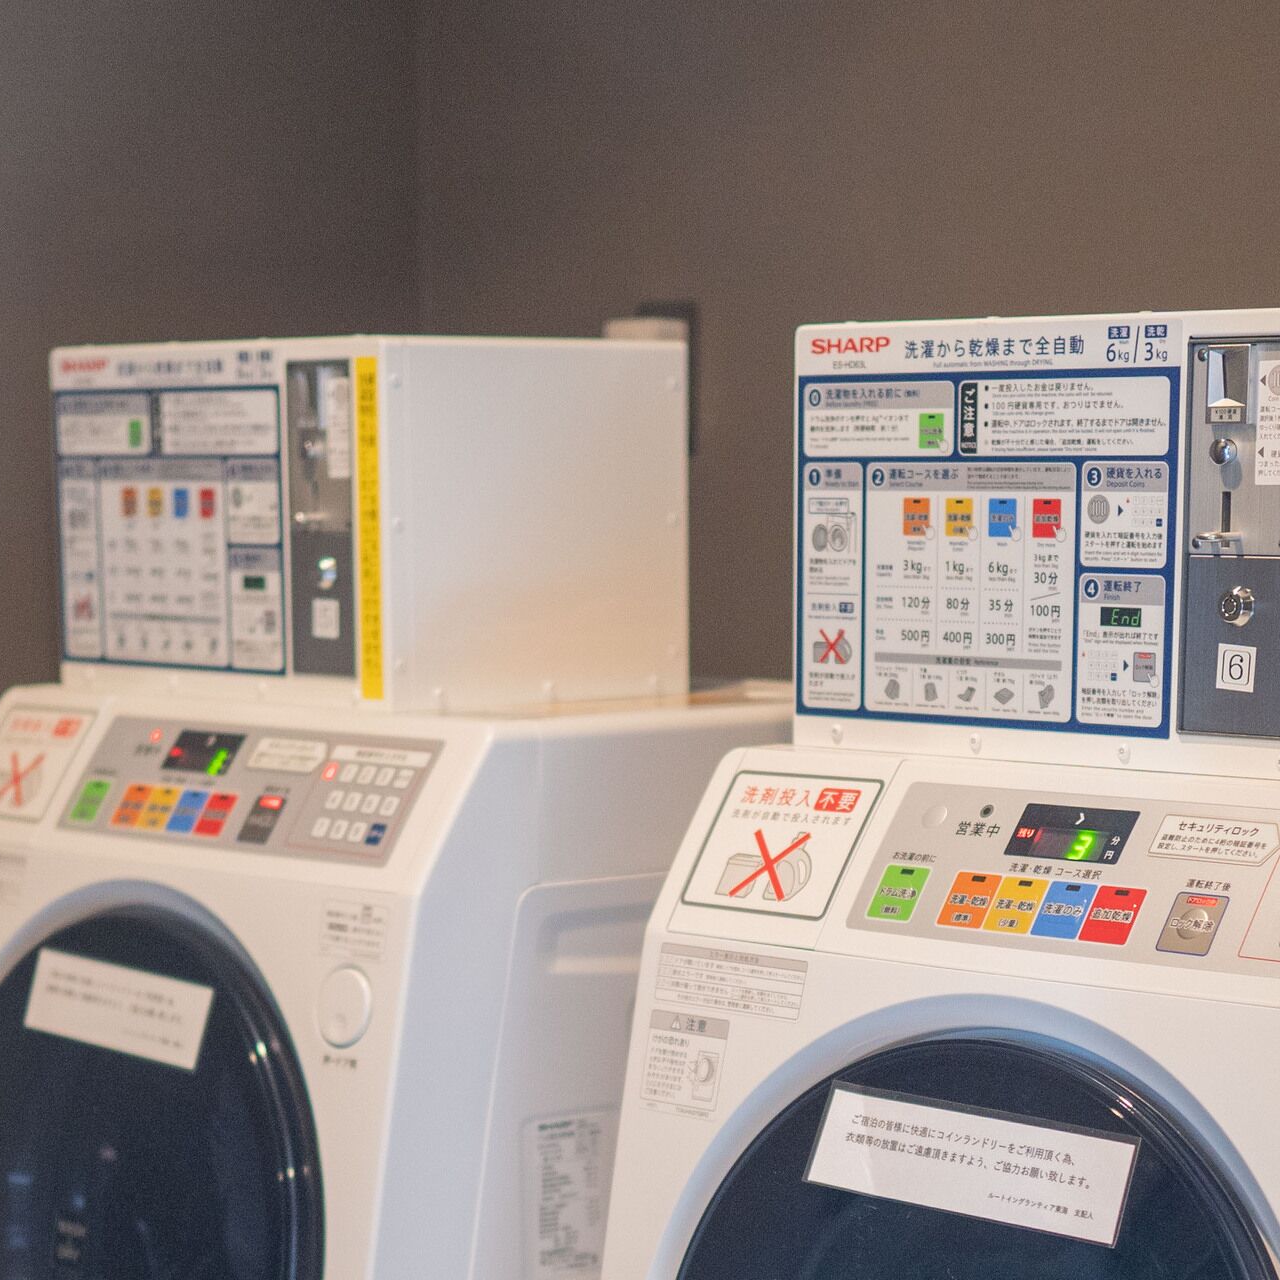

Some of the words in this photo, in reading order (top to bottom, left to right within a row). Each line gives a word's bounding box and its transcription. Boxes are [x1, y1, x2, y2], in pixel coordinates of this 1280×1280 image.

[811, 336, 890, 355] SHARP
[904, 335, 1085, 359] 洗濯から乾燥まで全自動
[963, 388, 976, 438] ご注意
[889, 468, 959, 480] 運転コースを選ぶ
[1106, 467, 1162, 479] 硬貨を入れる
[1103, 579, 1142, 592] 運転終了
[946, 597, 970, 611] 80分
[989, 599, 1013, 612] 35分
[1030, 604, 1061, 618] 100円
[1111, 608, 1141, 626] End
[901, 630, 930, 643] 500円
[942, 632, 972, 645] 400円
[986, 633, 1016, 646] 300円
[1229, 654, 1244, 680] 6
[740, 785, 810, 807] 洗剤投入
[819, 791, 859, 811] 不要
[955, 821, 1001, 838] 営業中
[1178, 820, 1260, 837] セキュリティロック
[1067, 835, 1093, 860] 3
[1111, 836, 1121, 846] 分
[892, 851, 937, 863] お洗濯の前に
[1104, 850, 1115, 860] 円
[1185, 879, 1231, 891] 運転終了後
[1044, 903, 1082, 917] 洗濯のみ
[1092, 908, 1133, 922] 追加乾燥
[1170, 918, 1214, 931] ロック解除
